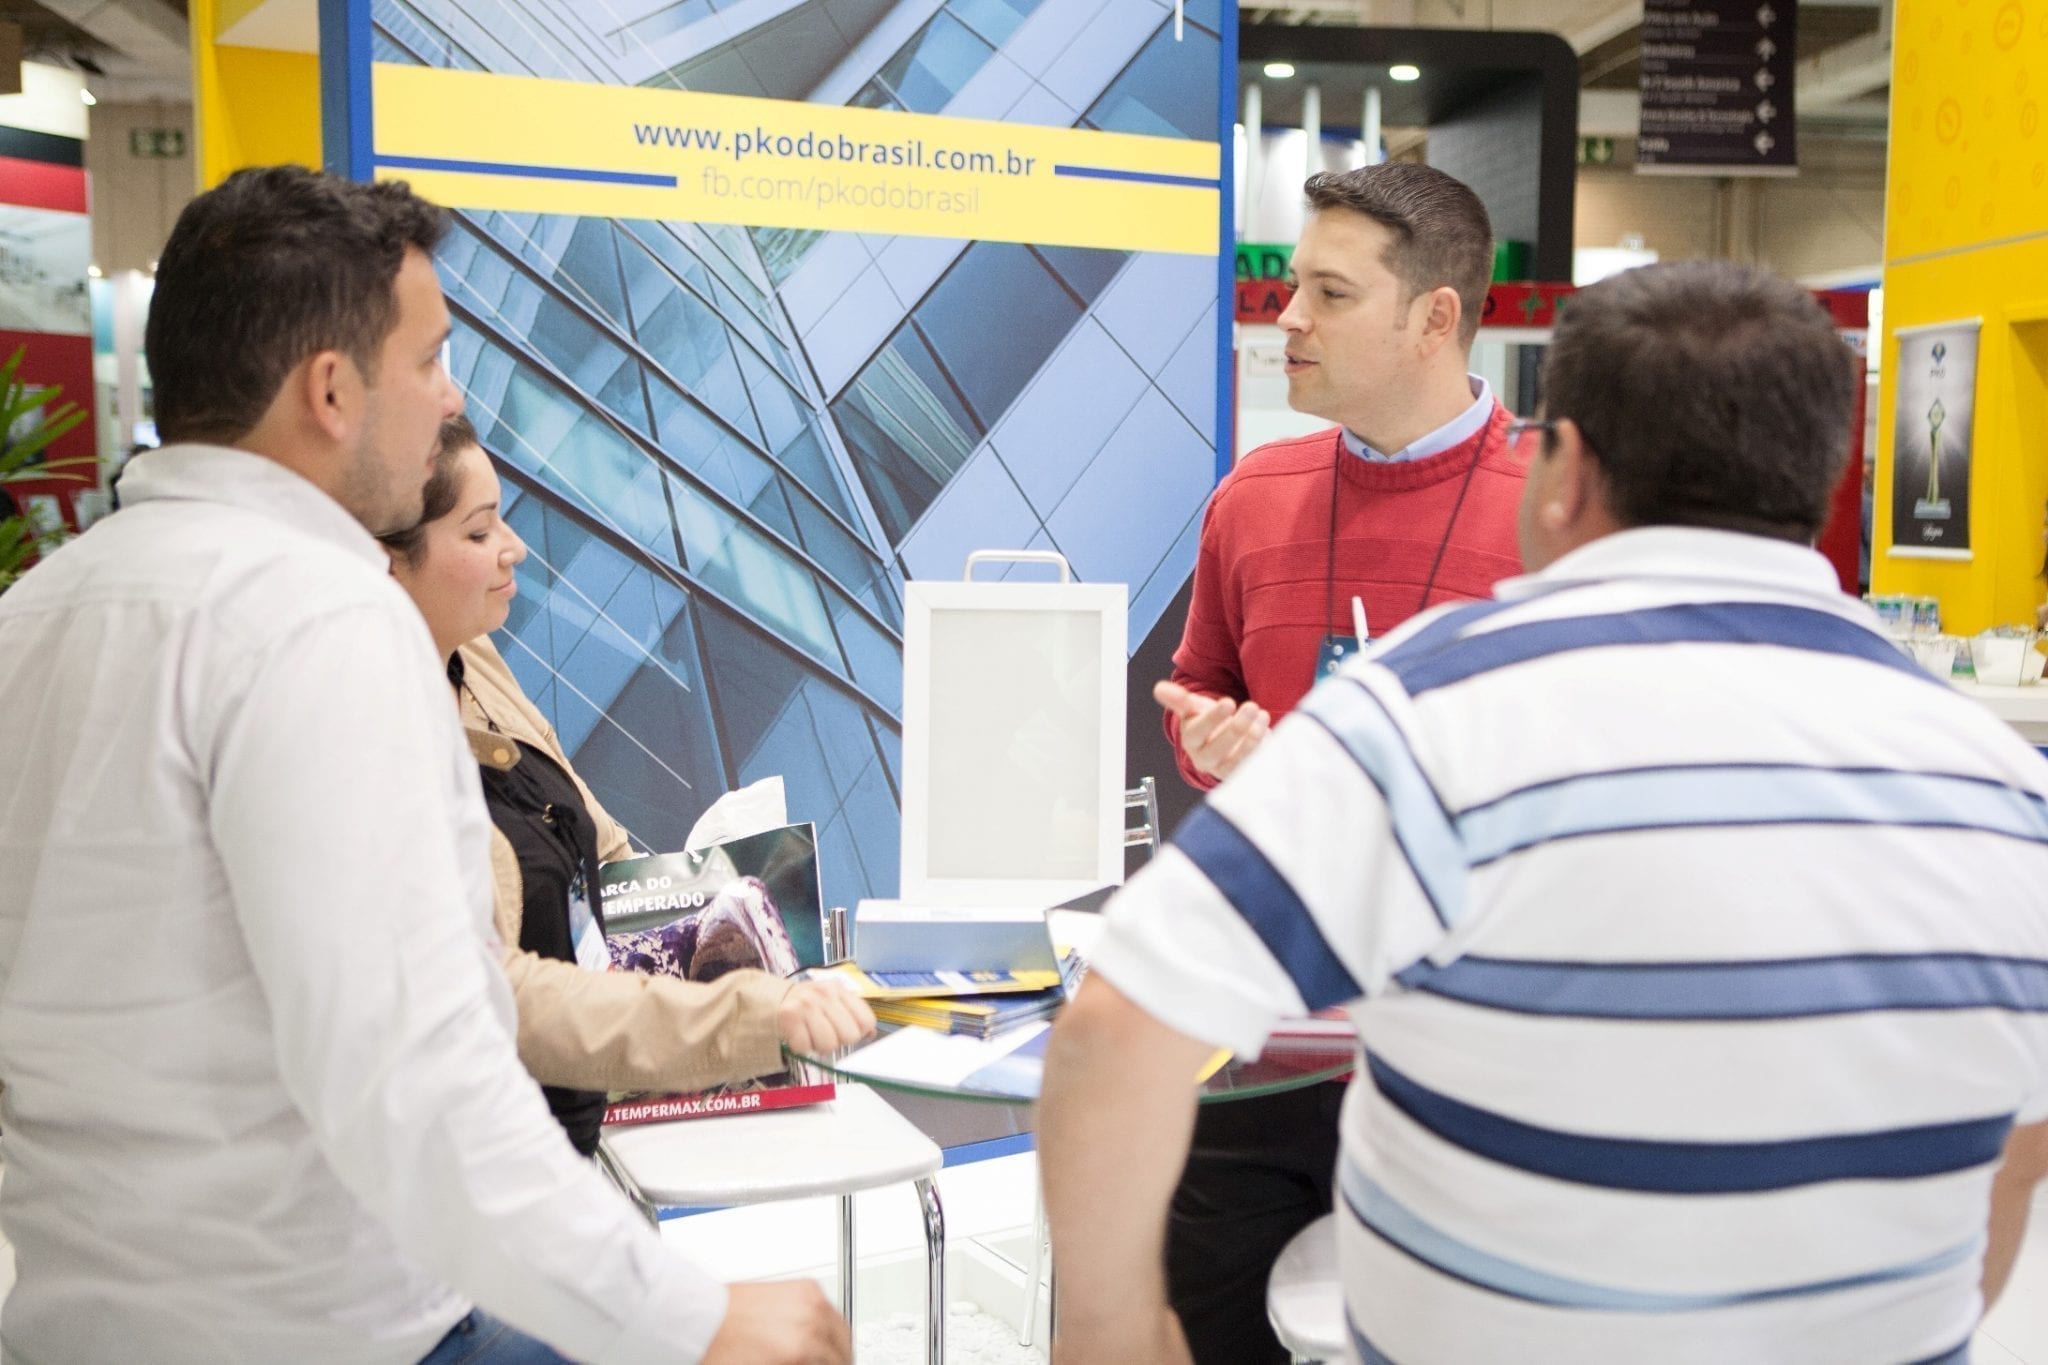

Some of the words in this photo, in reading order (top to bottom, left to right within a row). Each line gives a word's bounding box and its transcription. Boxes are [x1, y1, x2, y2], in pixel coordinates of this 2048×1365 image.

[634, 123, 1036, 176] www.pkodobrasil.com.br
[702, 165, 980, 214] fb.com/pkodobrasil
[646, 875, 673, 890] DO
